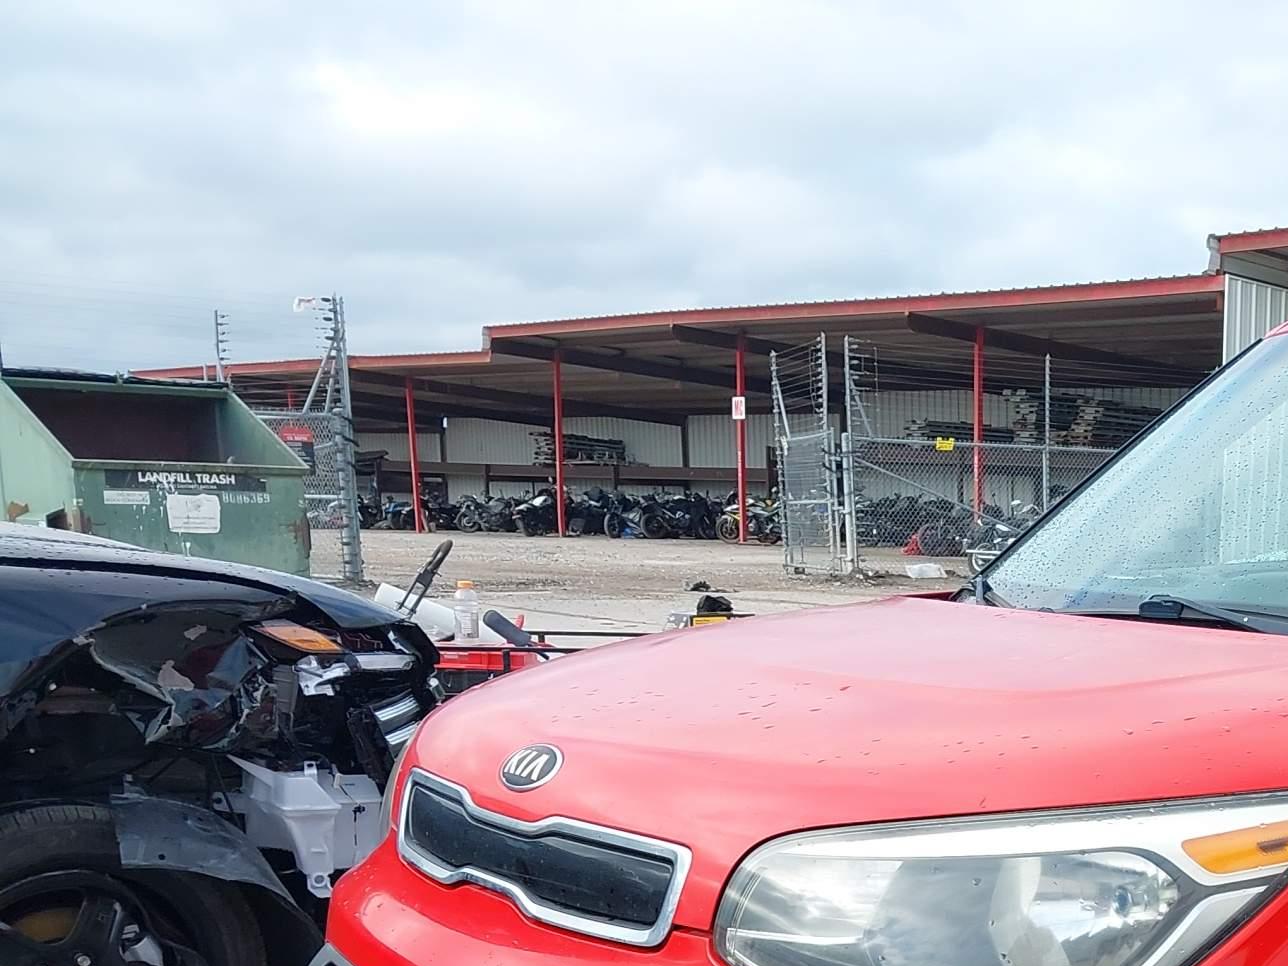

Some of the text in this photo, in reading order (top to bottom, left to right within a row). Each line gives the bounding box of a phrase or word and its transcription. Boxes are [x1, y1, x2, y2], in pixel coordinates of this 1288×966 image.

[137, 471, 236, 486] LANDFILL TRASH
[504, 750, 550, 781] KIA
